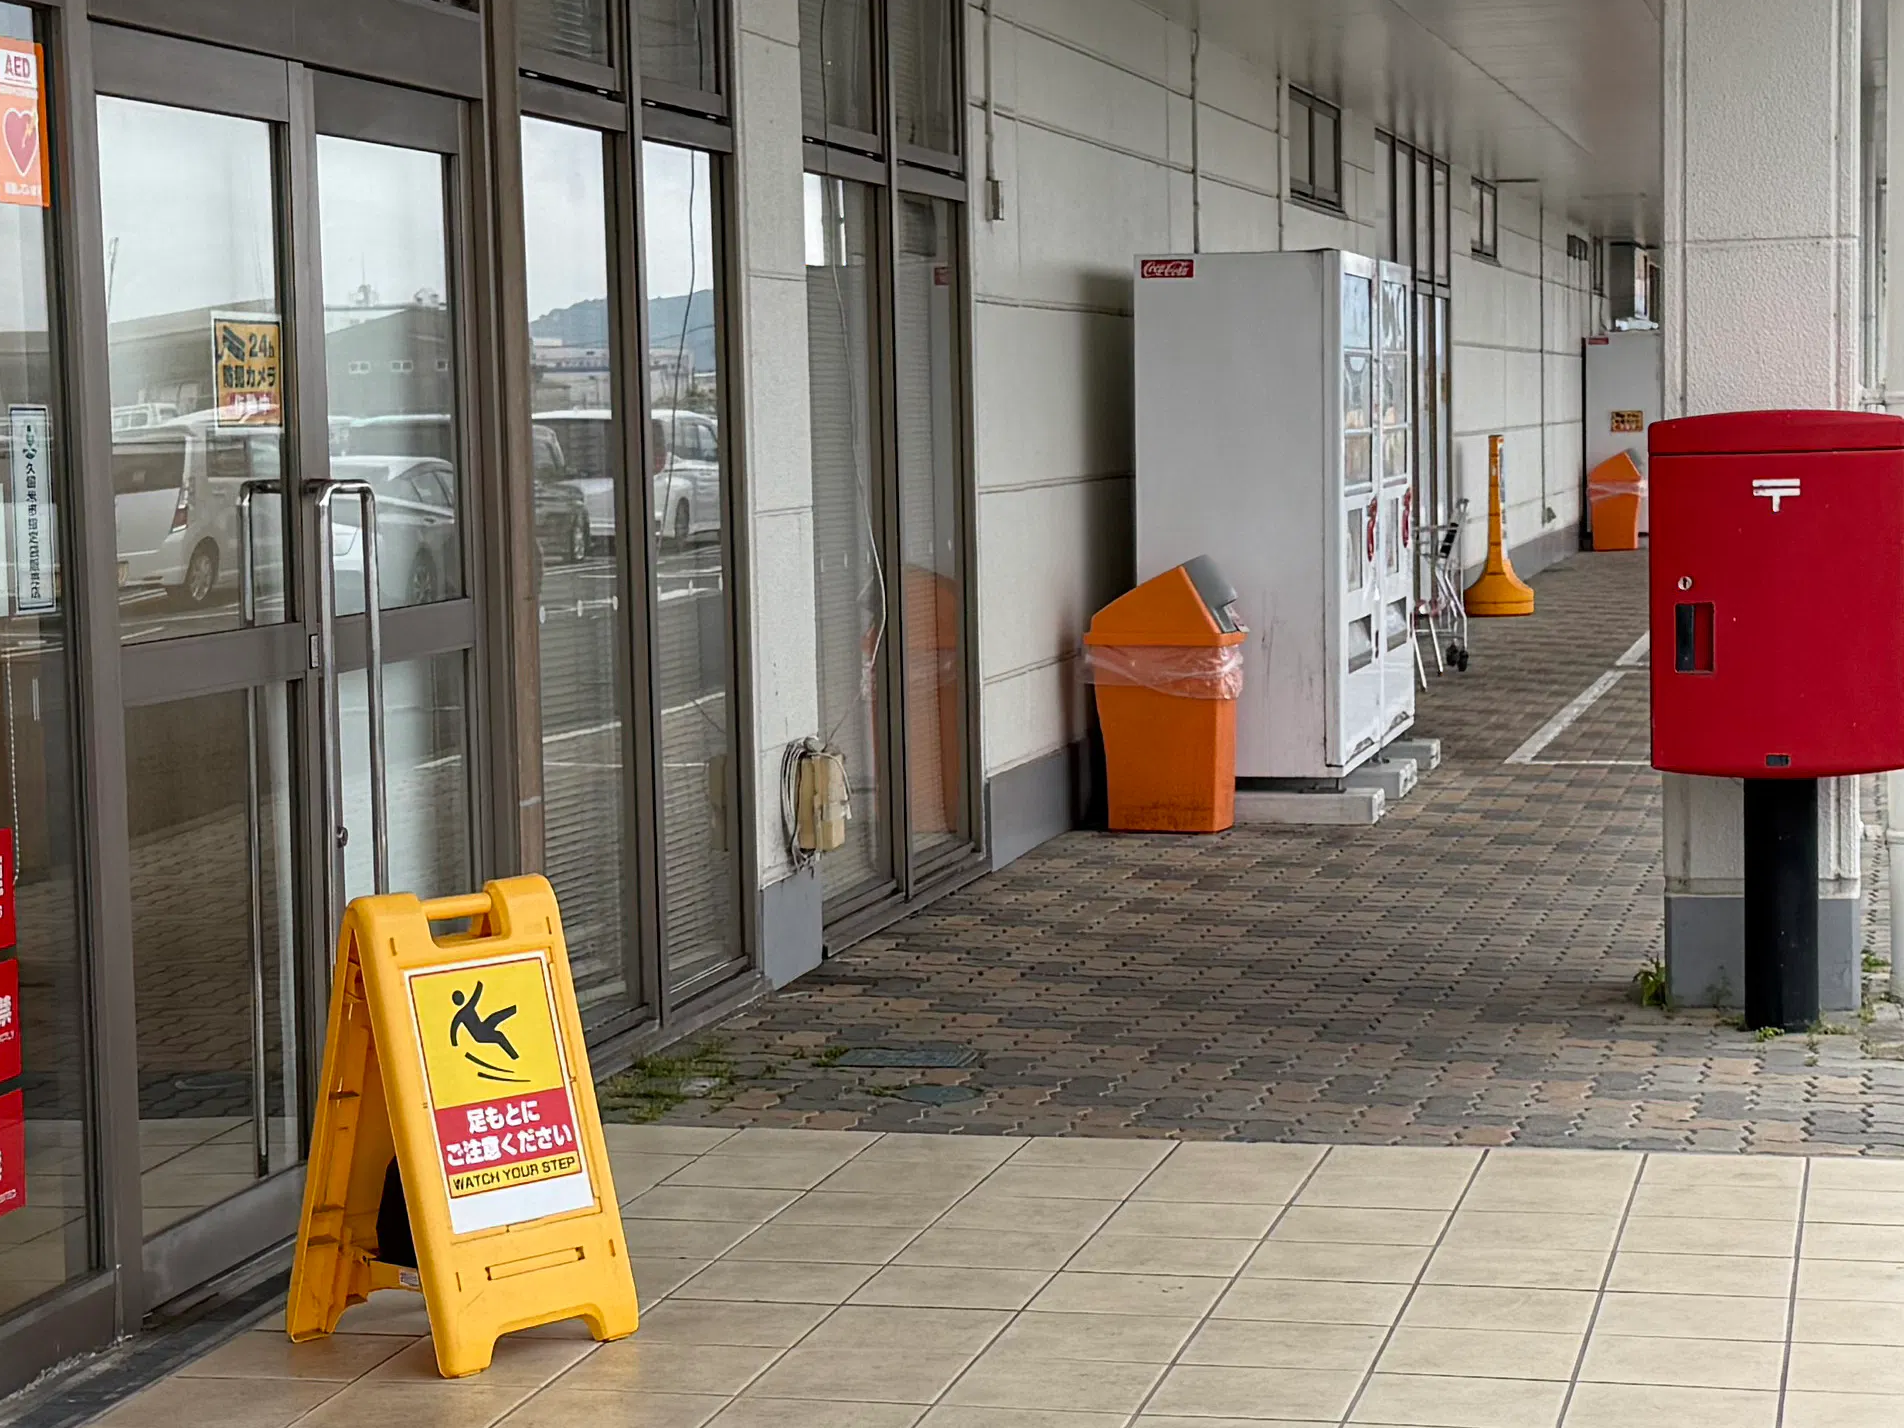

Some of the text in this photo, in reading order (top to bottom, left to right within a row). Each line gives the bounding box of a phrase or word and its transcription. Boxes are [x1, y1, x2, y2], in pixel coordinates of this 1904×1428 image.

[4, 54, 31, 79] AED
[1143, 261, 1191, 277] Coca-Cola
[466, 1100, 541, 1134] 足もとに
[445, 1123, 573, 1167] ご注意ください
[452, 1156, 575, 1191] WATCH YOUR STEP
